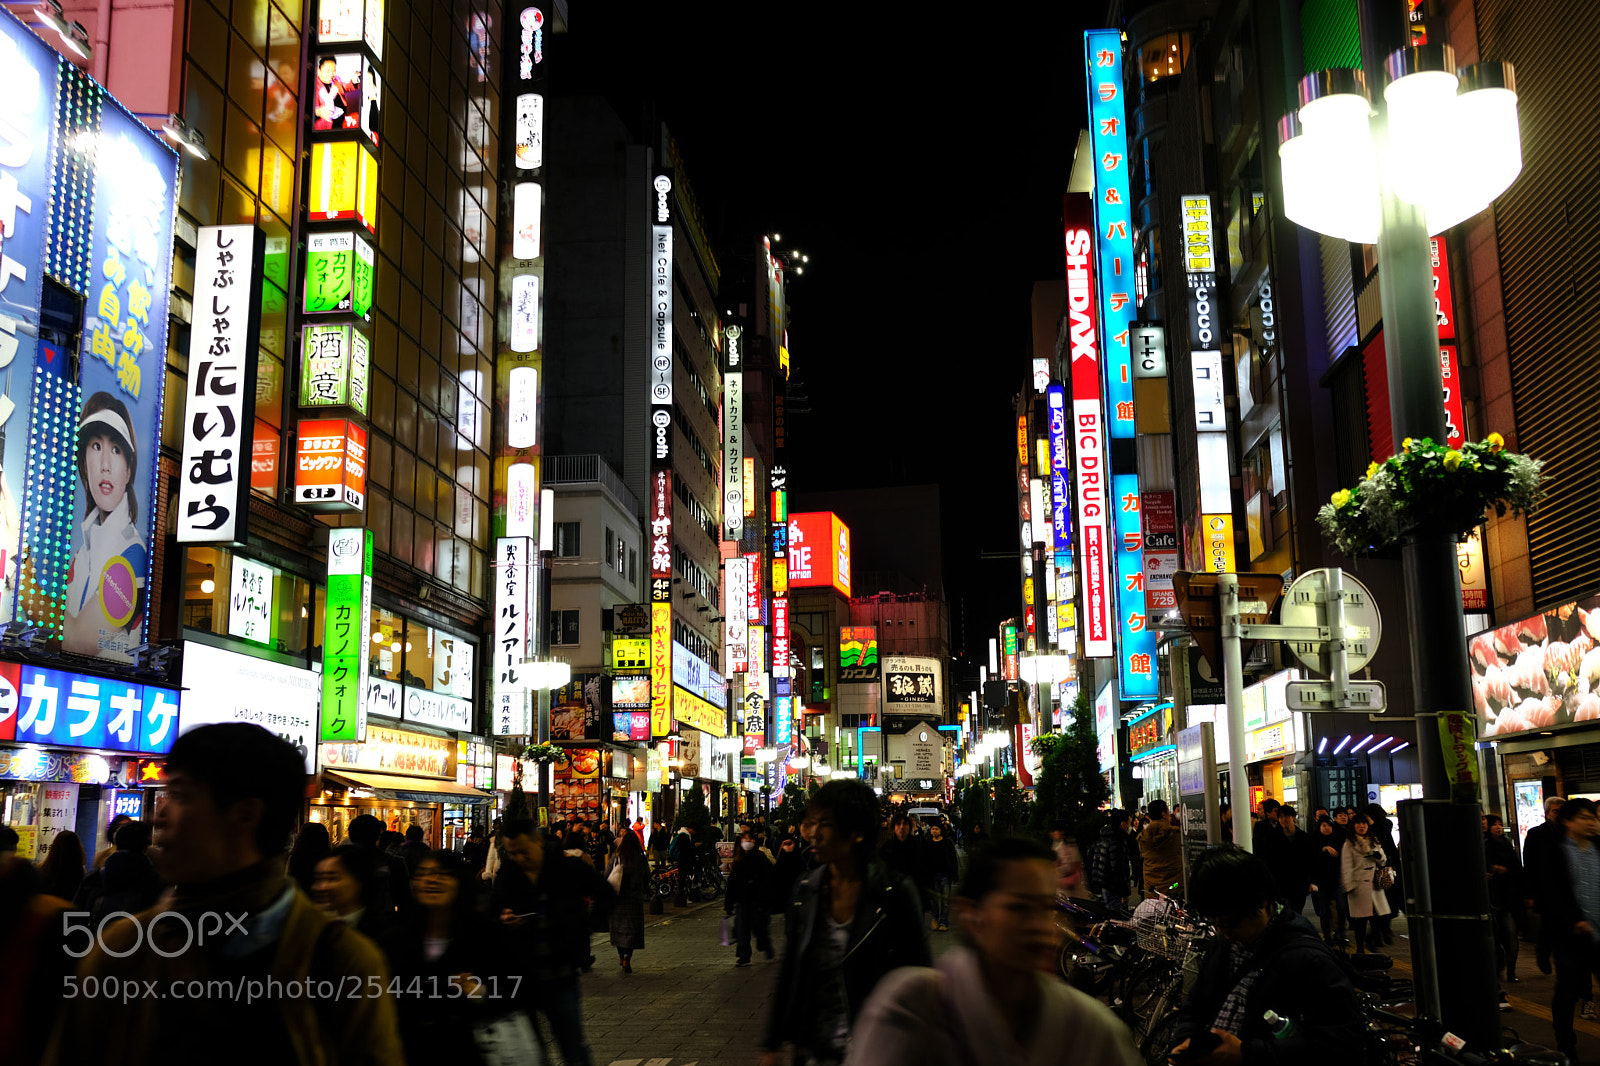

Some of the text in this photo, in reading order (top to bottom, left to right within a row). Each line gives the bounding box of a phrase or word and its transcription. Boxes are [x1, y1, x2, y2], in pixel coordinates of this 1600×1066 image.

[657, 234, 667, 253] Net
[208, 229, 234, 356] しゃぶしゃぶ
[313, 258, 328, 310] クォーク
[657, 258, 667, 285] Cafe
[1065, 228, 1096, 362] SHIDAX
[116, 278, 152, 399] 飲み物
[657, 302, 668, 350] Capsule
[1196, 287, 1213, 343] COCO
[729, 380, 739, 431] ネットカフェ
[1195, 367, 1213, 425] ココ
[187, 360, 237, 530] にいむら
[653, 410, 671, 459] Booth
[1079, 413, 1101, 518] BIC DRUG
[651, 517, 671, 573] 甘太郎
[1145, 535, 1175, 547] Cafe
[232, 592, 268, 620] ルノアール
[653, 580, 669, 590] 4F
[653, 591, 669, 600] 3F
[1122, 493, 1152, 674] カラオケ館
[1152, 597, 1175, 606] 729
[244, 621, 256, 637] 2F
[501, 604, 520, 685] ルノアール
[617, 648, 646, 658] ロード
[330, 604, 351, 734] カワノ・クォーク
[654, 625, 667, 733] やきとりセンター
[17, 674, 179, 746] カラオケ
[745, 691, 765, 733] 金の蔵
[745, 737, 758, 747] 2F
[116, 797, 140, 814] カラオケ
